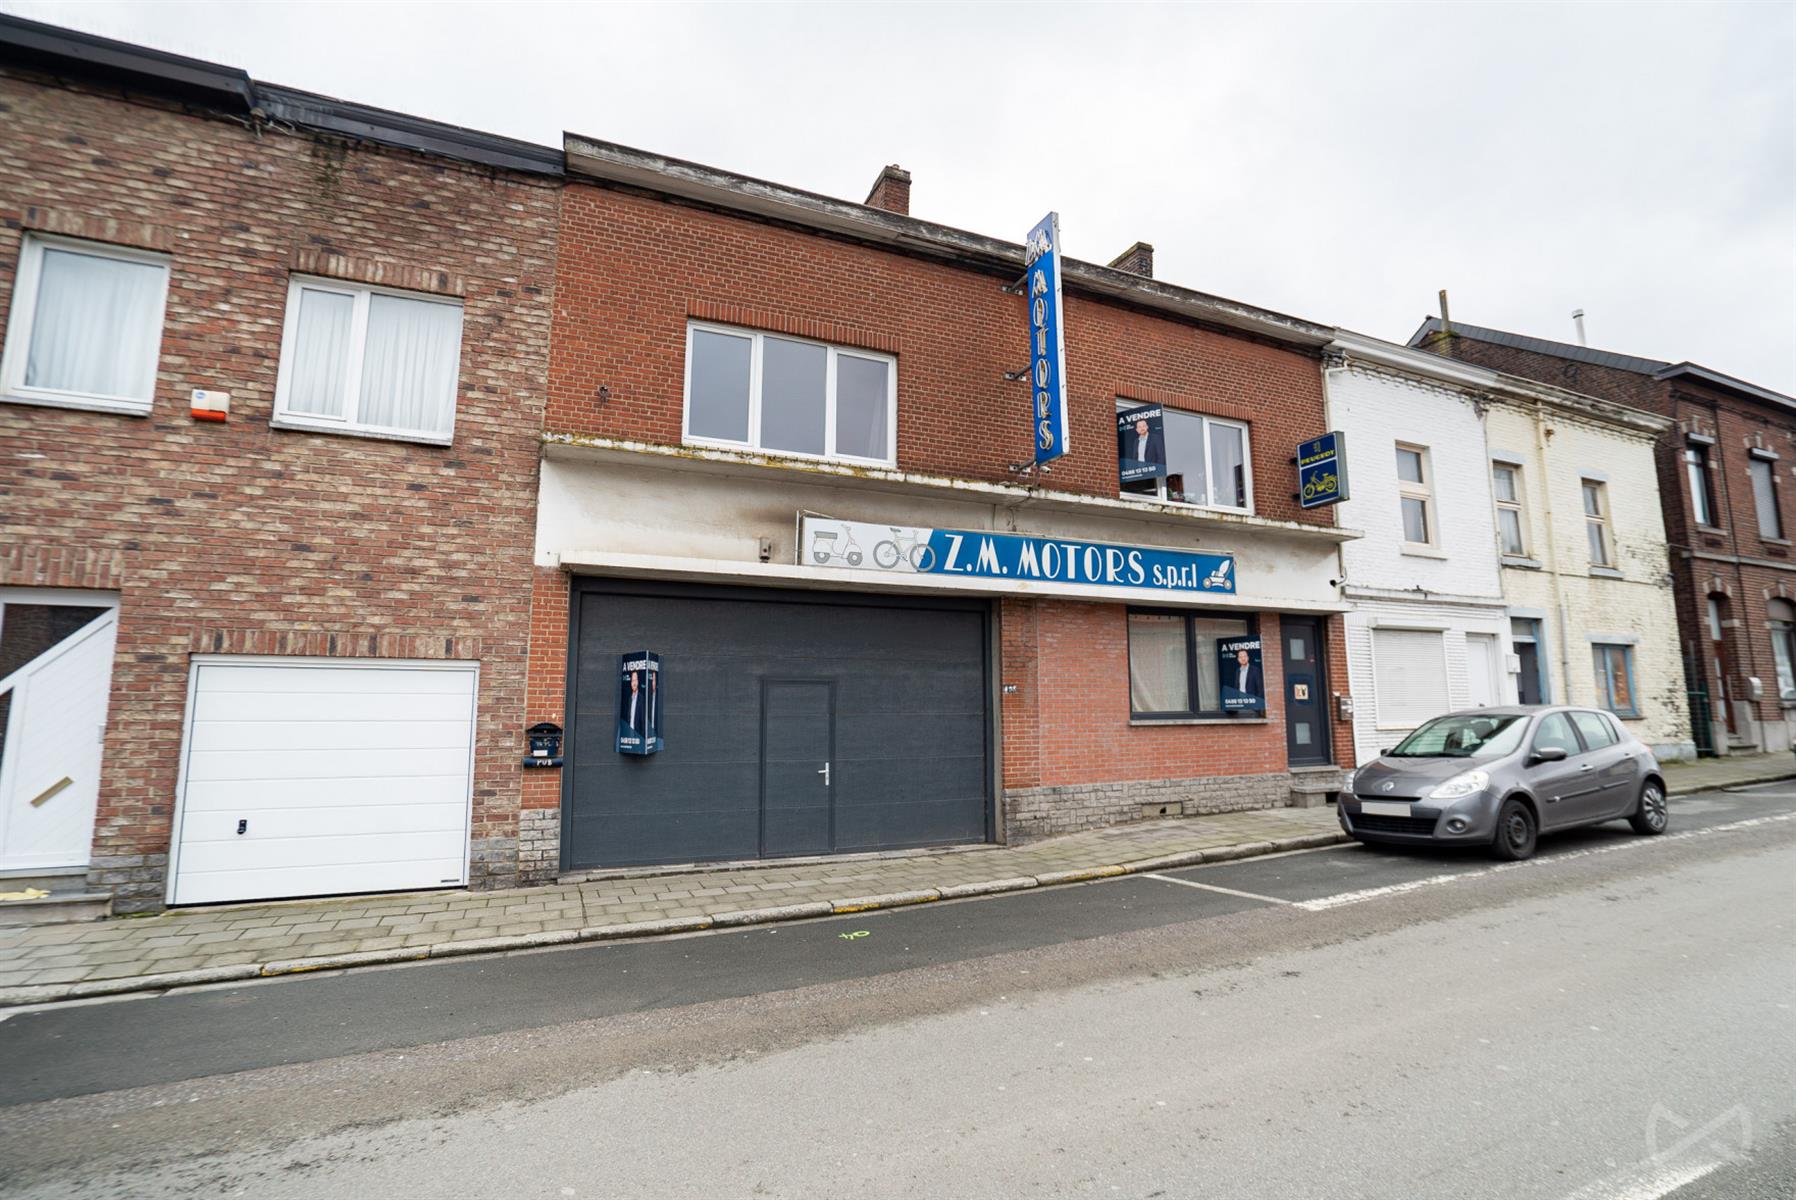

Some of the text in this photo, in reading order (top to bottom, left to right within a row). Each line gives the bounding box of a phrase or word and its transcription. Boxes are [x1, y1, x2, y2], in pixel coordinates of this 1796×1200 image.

[1032, 269, 1054, 450] MOTORS
[1118, 409, 1161, 425] A VENDRE
[943, 533, 1008, 574] Z.M.
[1017, 540, 1145, 584] MOTORS
[1221, 641, 1261, 652] A VENDRE
[627, 660, 647, 671] VENDRE
